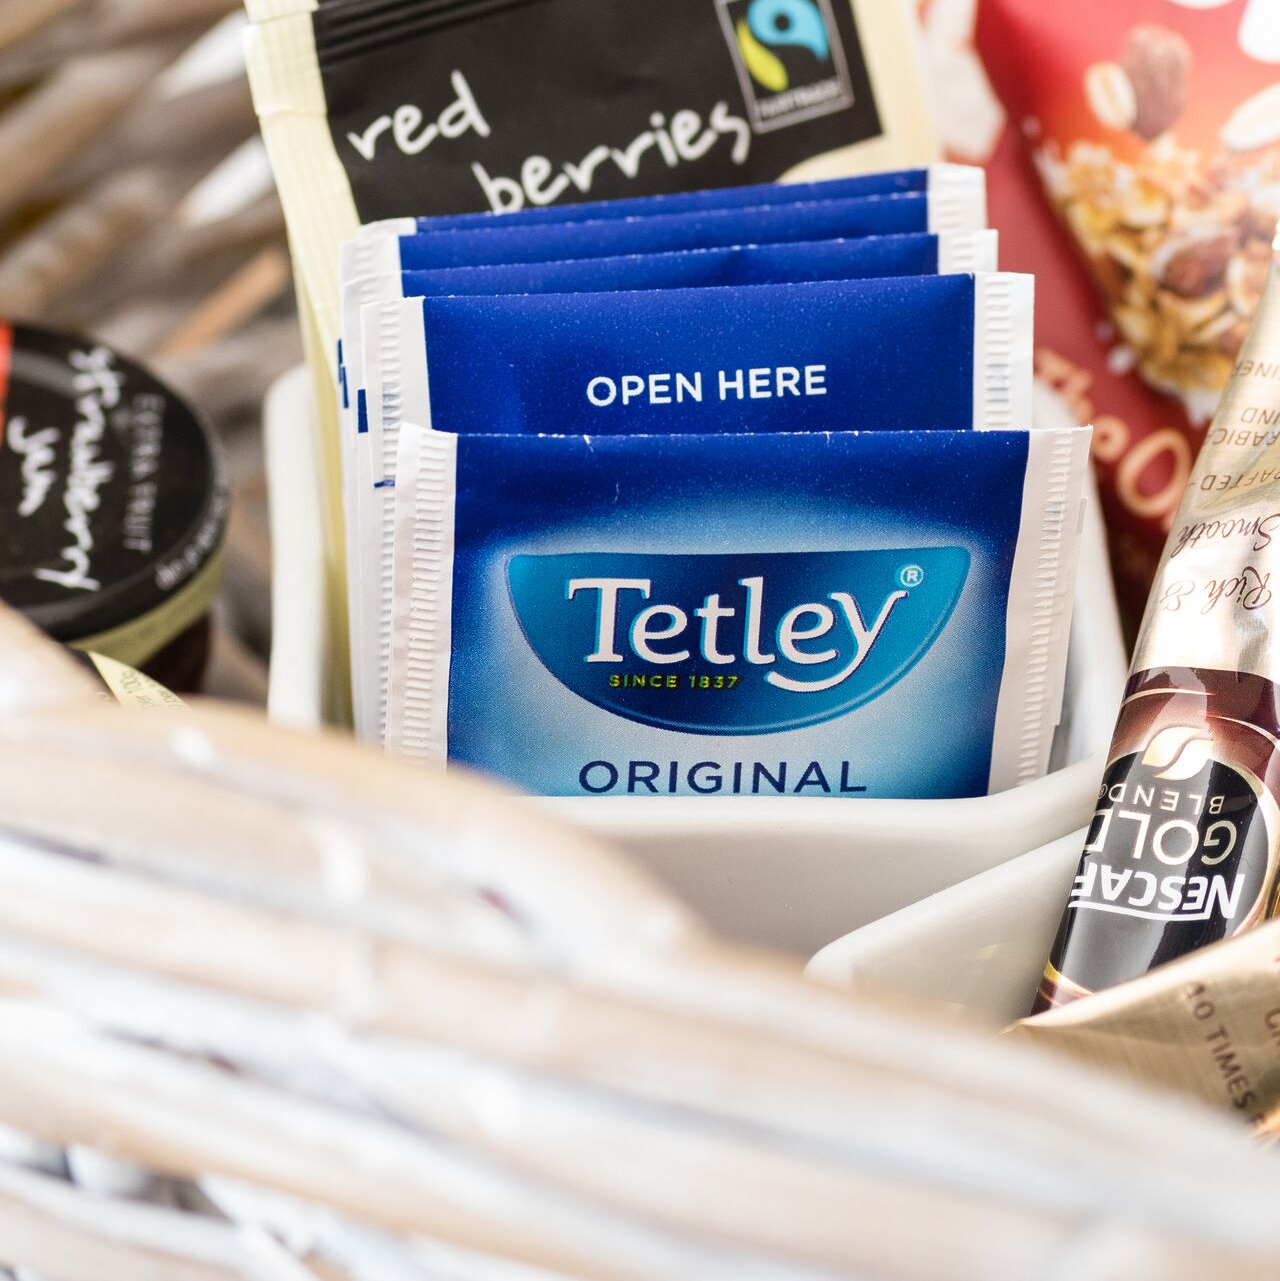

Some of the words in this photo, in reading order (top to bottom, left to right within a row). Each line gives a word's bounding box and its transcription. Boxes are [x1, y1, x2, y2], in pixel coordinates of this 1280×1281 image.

[348, 70, 490, 160] red
[473, 103, 750, 216] berries
[587, 370, 703, 407] OPEN
[718, 365, 828, 402] HERE
[1198, 558, 1275, 625] Rich
[565, 577, 910, 694] Tetley
[609, 674, 679, 689] SINCE
[687, 674, 740, 690] 1837
[578, 759, 868, 796] ORIGINAL
[1108, 783, 1225, 815] BLEND
[1068, 862, 1246, 921] NESCAF
[1194, 1021, 1266, 1113] TIMES
